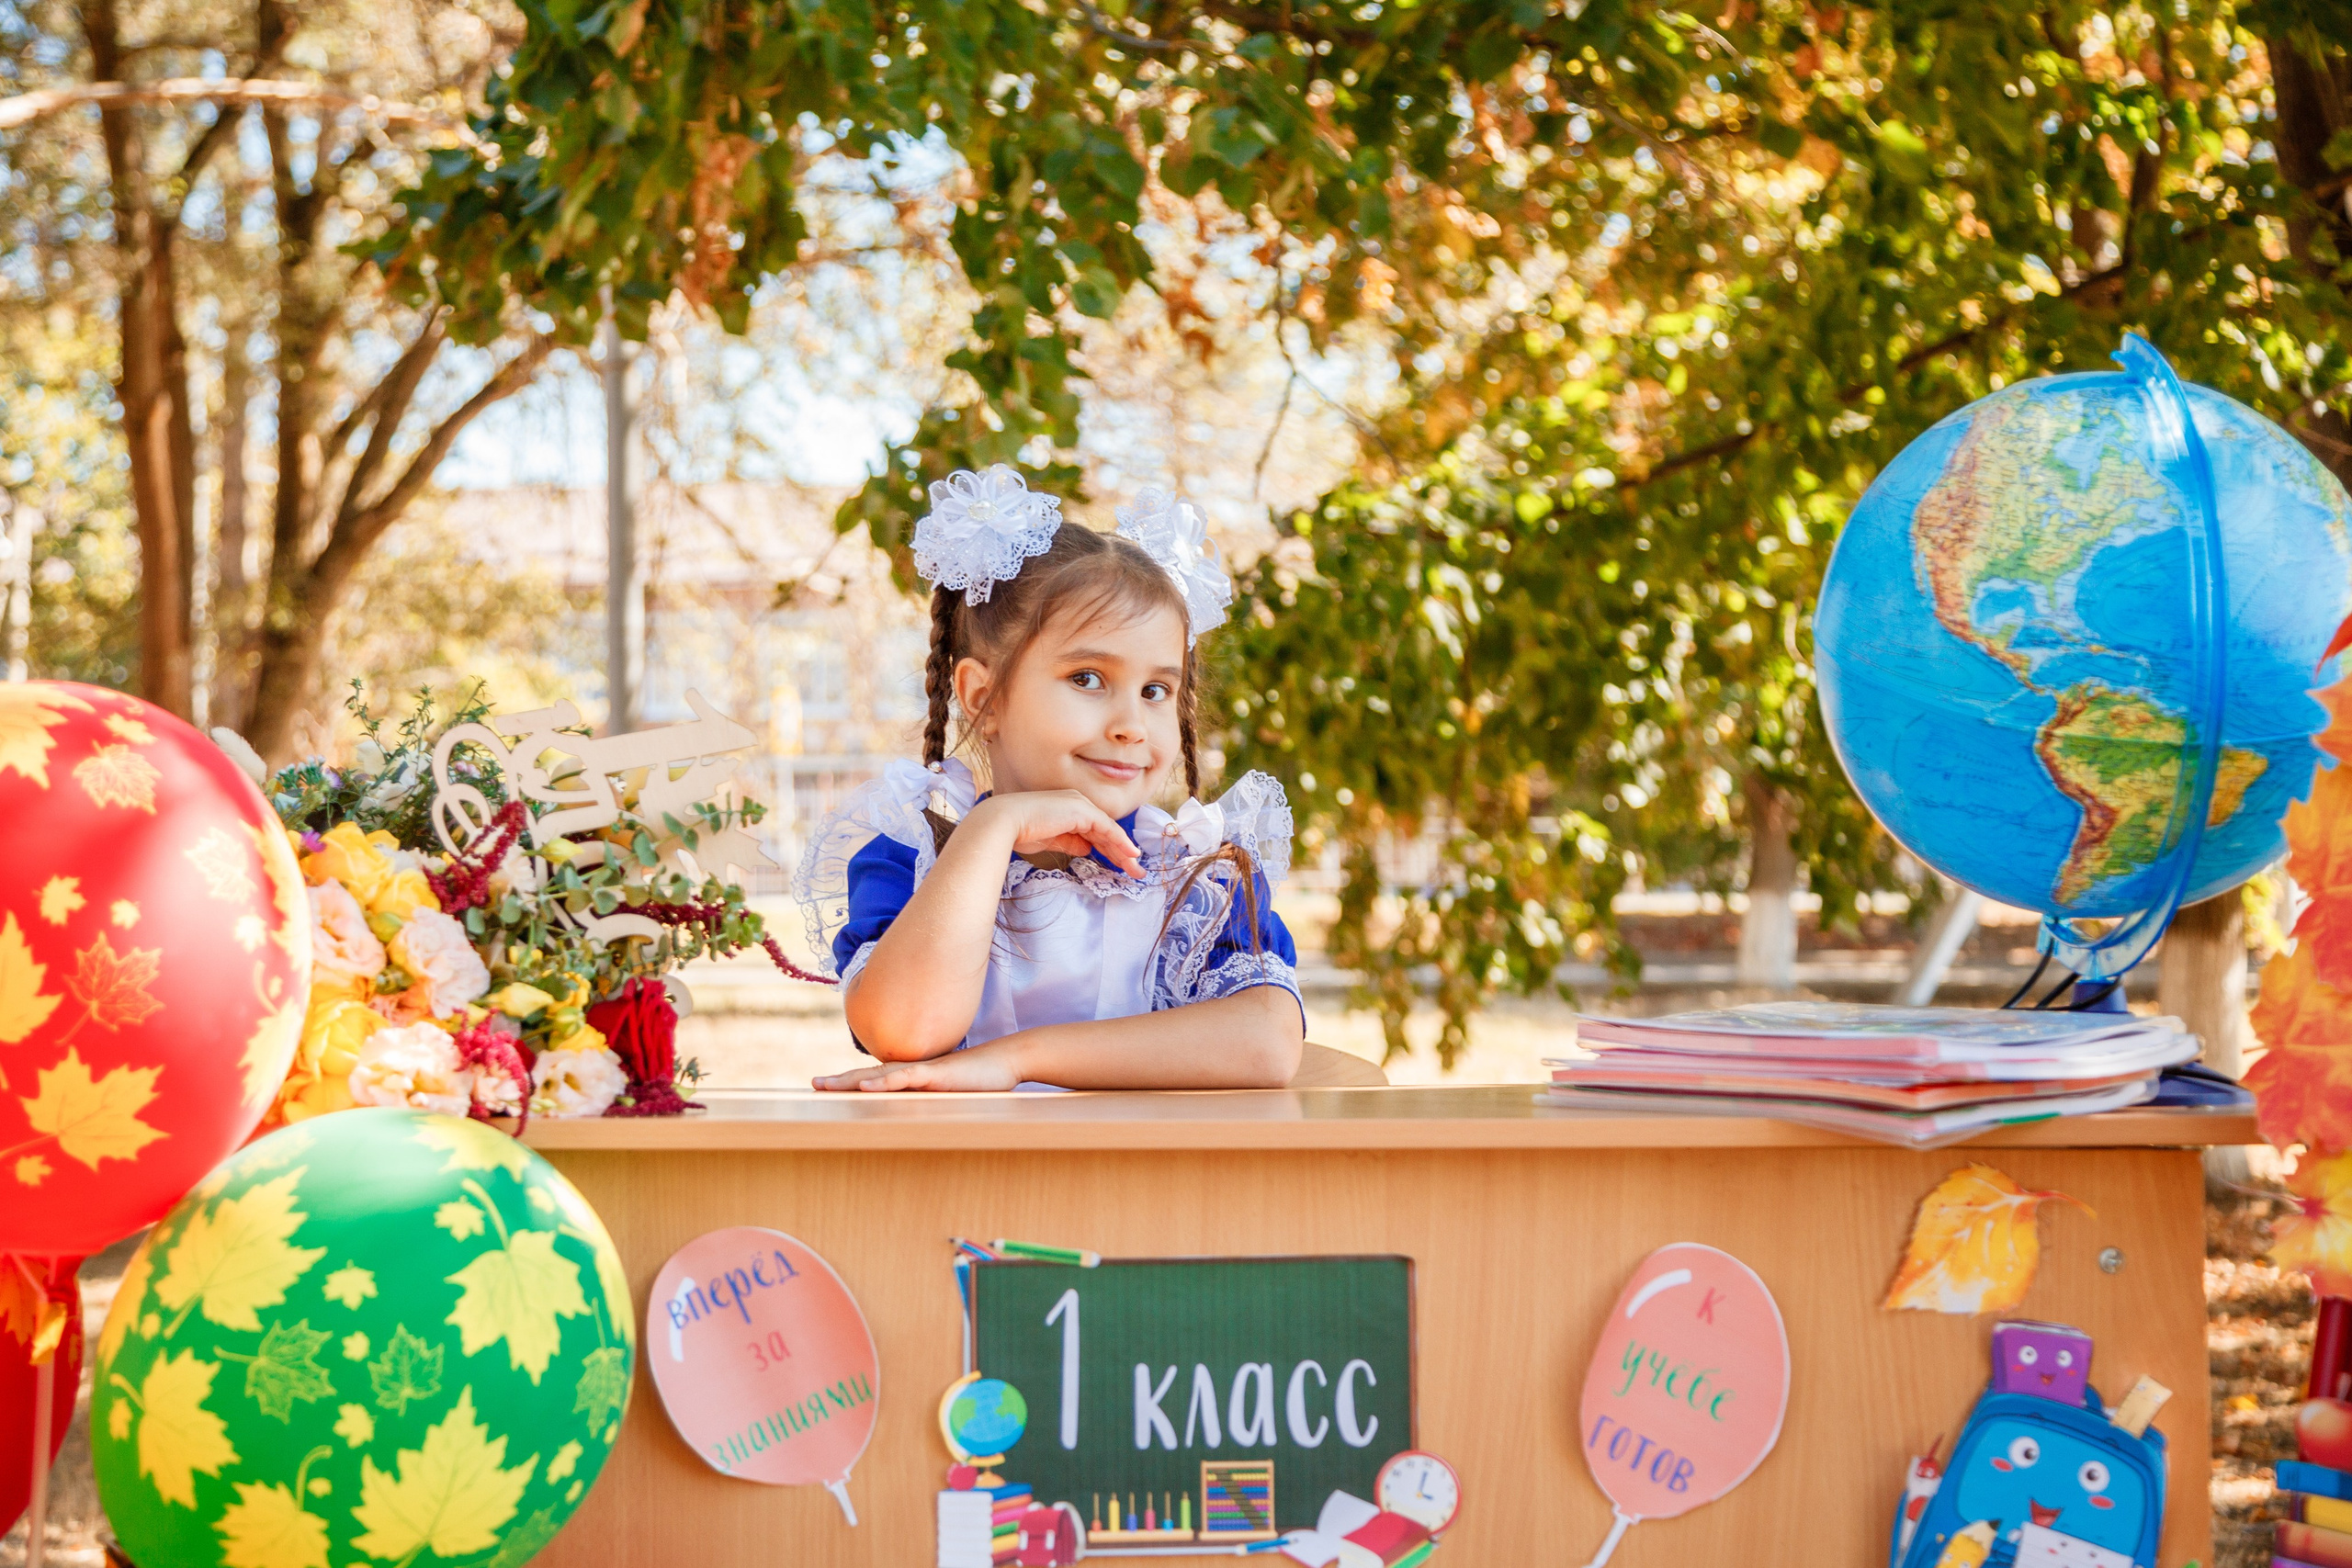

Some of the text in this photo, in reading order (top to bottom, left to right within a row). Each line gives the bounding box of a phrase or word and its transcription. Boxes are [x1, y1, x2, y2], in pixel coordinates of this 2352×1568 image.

[666, 1250, 799, 1330] вперёд
[747, 1331, 792, 1372] за
[1045, 1288, 1378, 1450] 1 класс
[711, 1372, 874, 1473] знаниями
